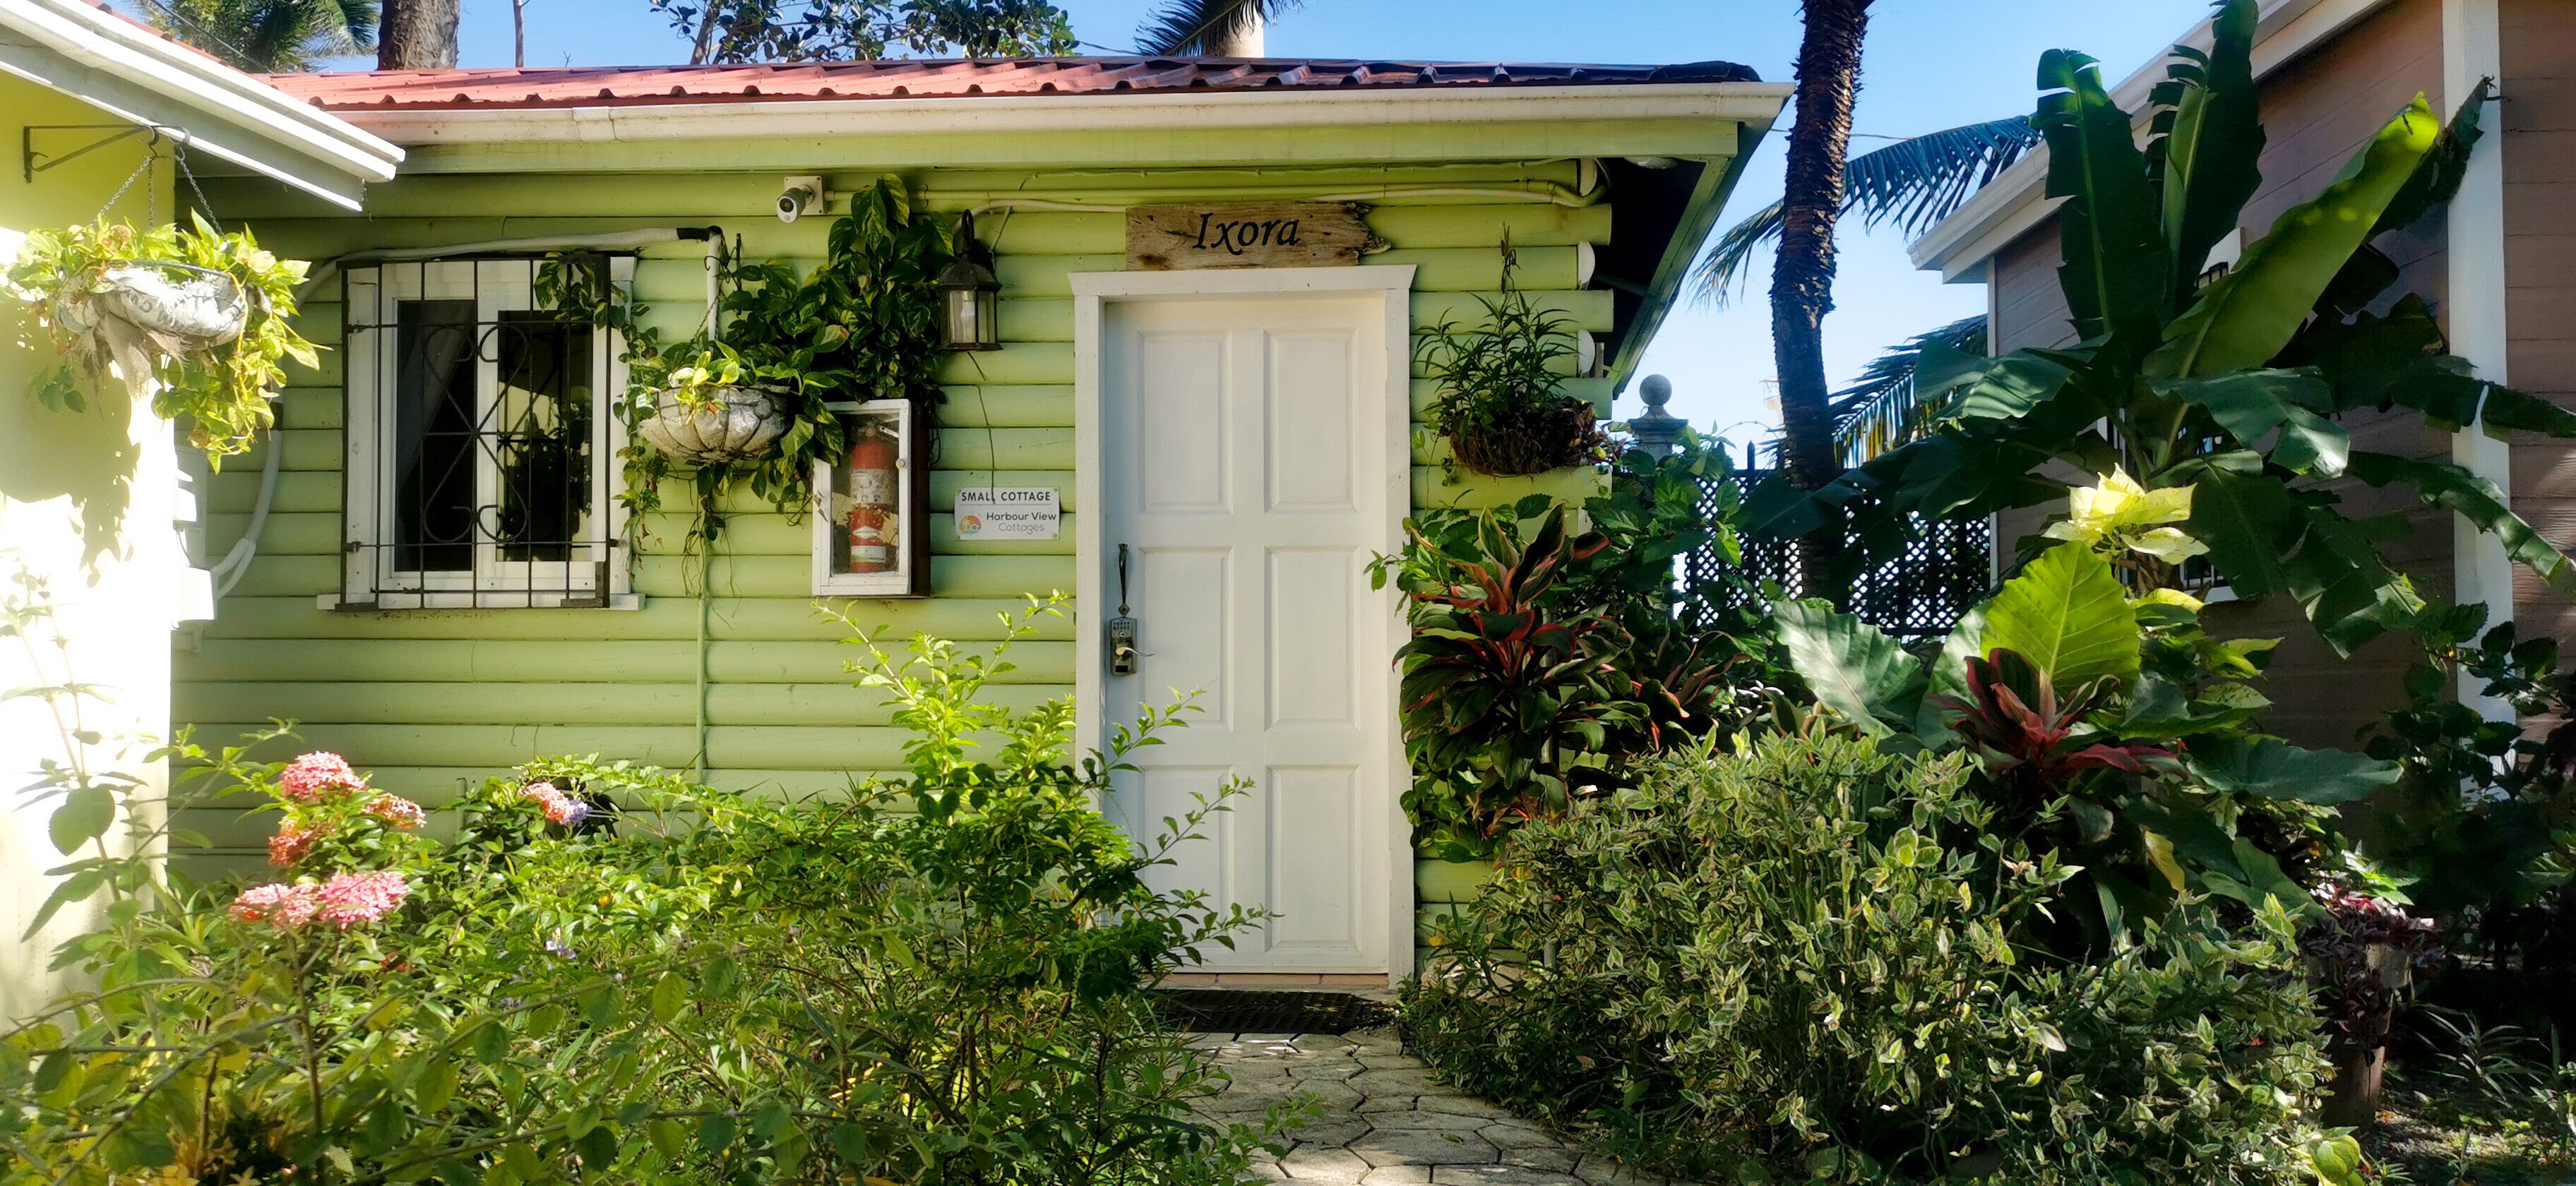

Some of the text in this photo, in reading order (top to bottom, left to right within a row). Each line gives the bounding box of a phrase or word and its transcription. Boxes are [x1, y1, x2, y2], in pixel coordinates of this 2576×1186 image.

[1192, 212, 1301, 256] Ixora
[962, 491, 1050, 501] SMALL COTTAGE
[1032, 512, 1056, 520] View
[998, 523, 1044, 534] Cottages
